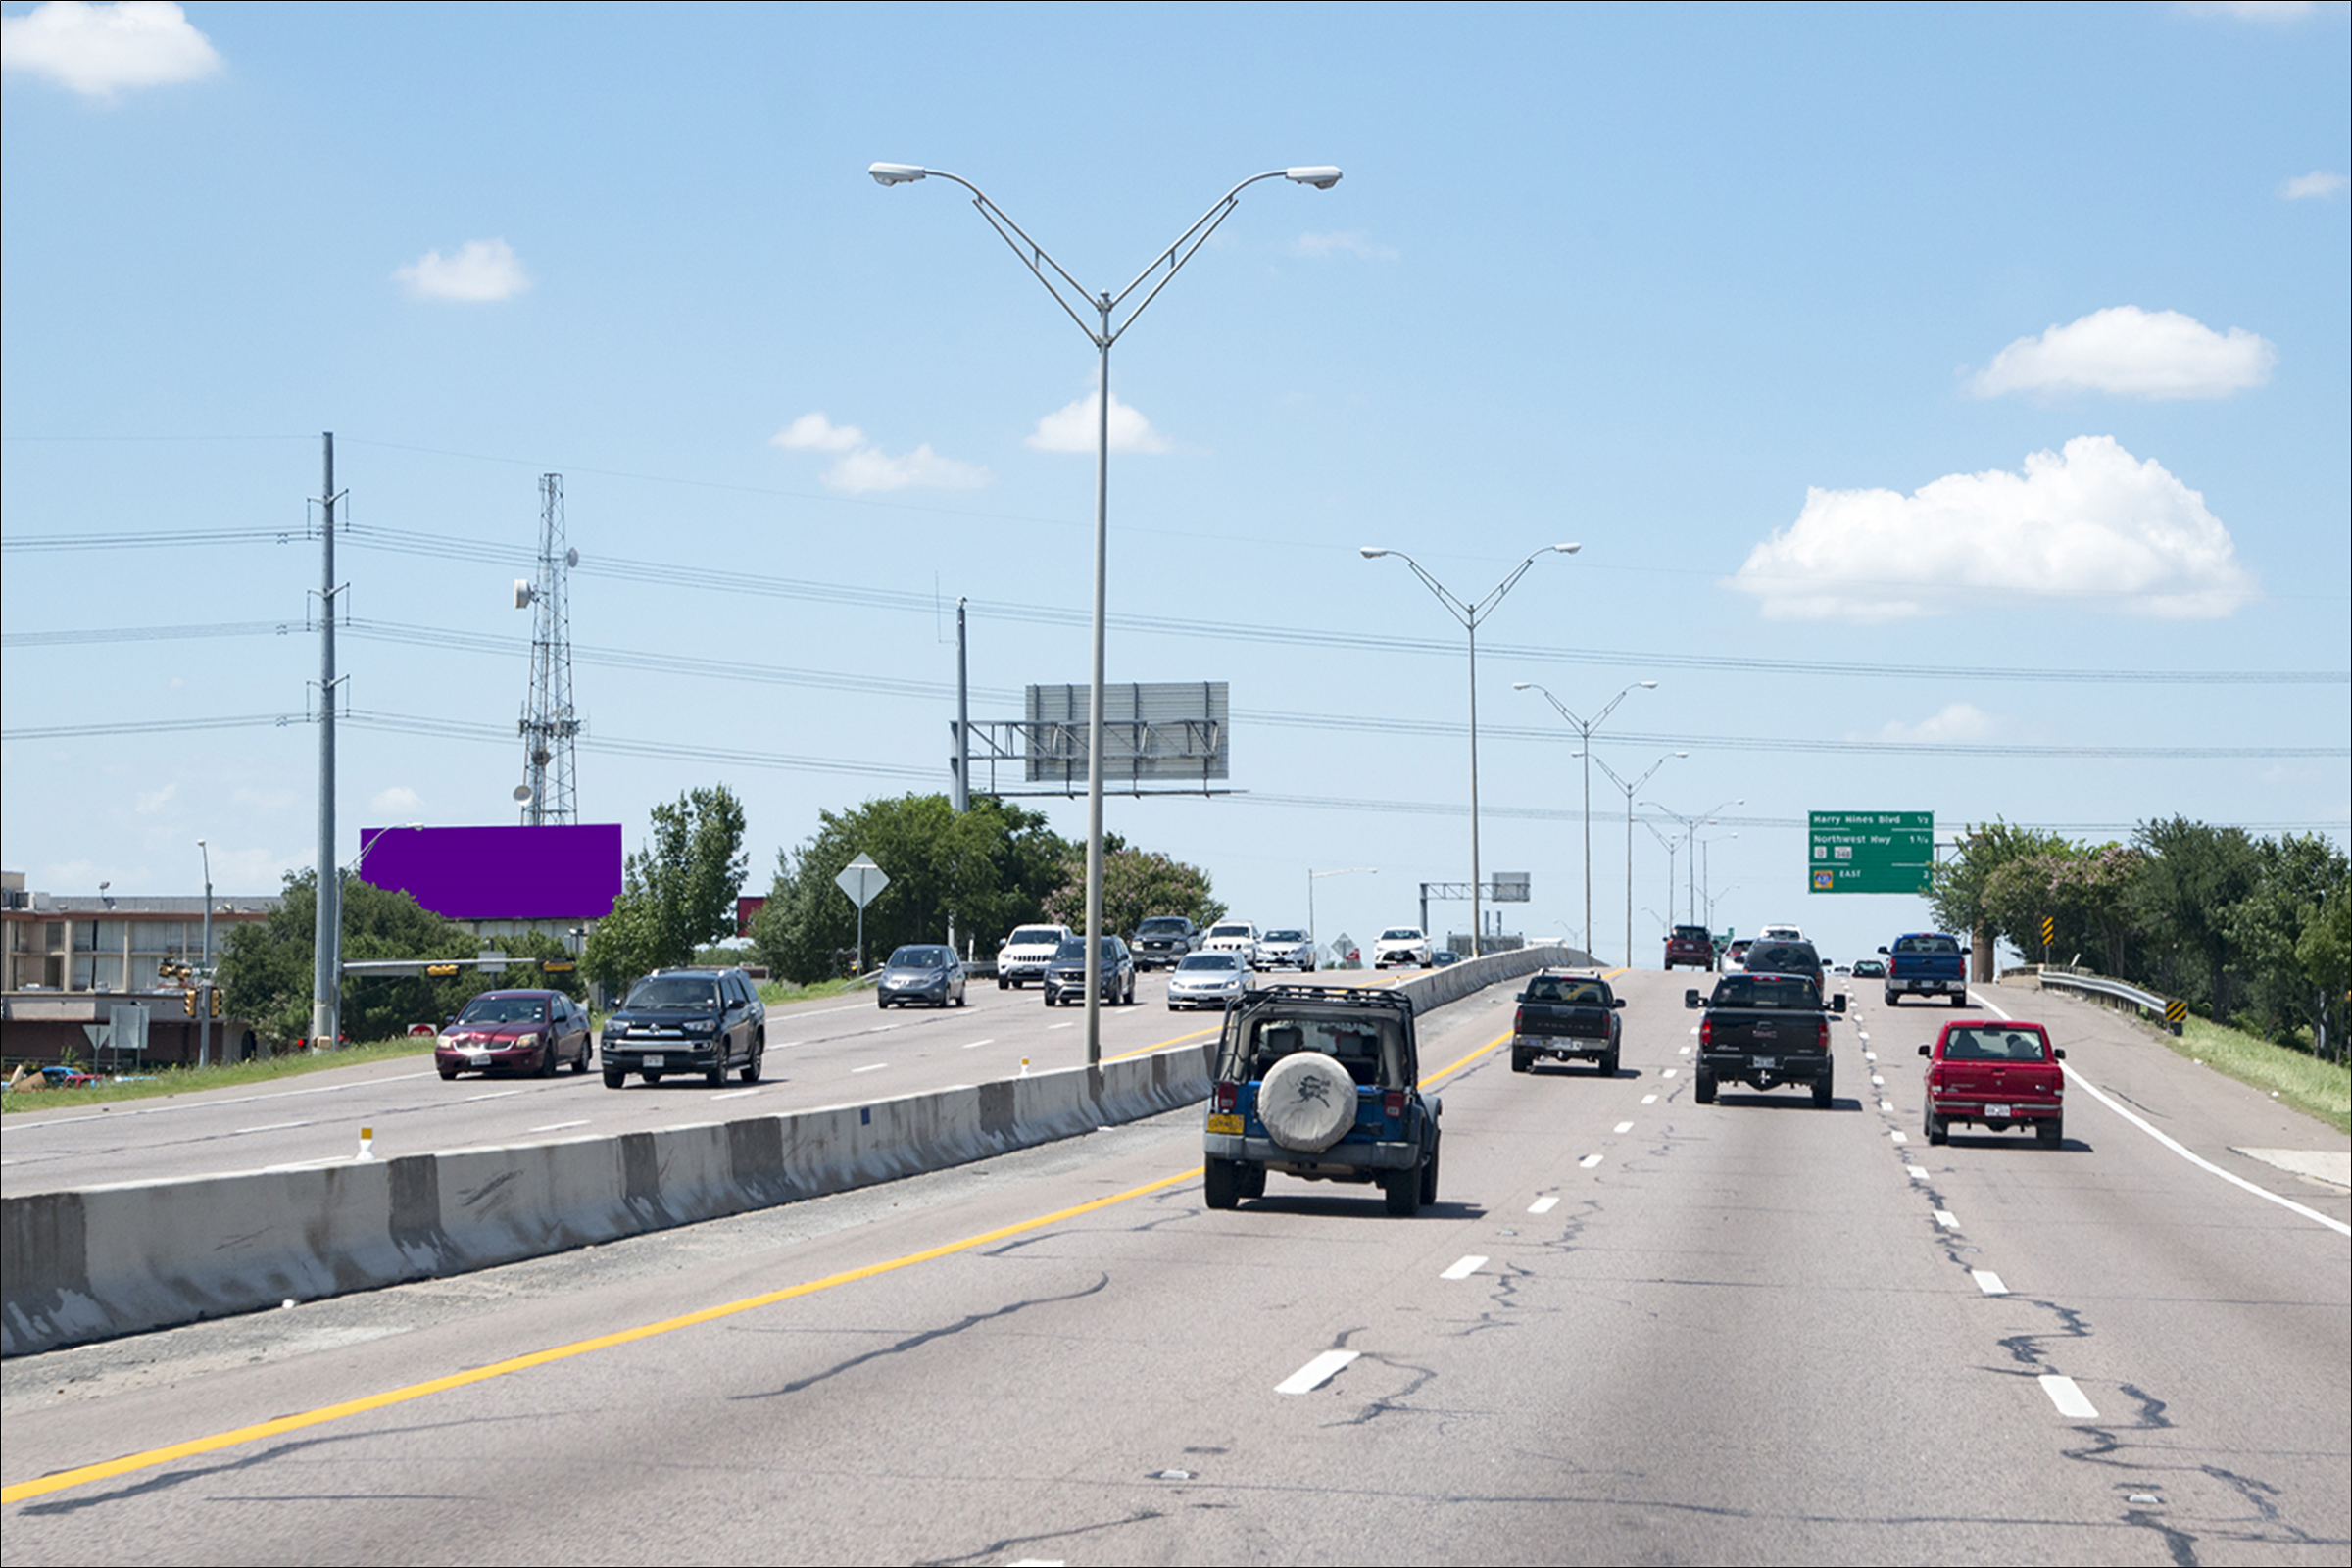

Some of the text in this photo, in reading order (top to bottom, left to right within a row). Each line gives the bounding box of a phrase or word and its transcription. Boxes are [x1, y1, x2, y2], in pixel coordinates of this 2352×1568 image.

[1813, 815, 1901, 825] Harry Hines Blvd
[1813, 835, 1892, 845] Northwest Hwy
[1839, 869, 1861, 878] EAST
[1923, 870, 1929, 879] 2
